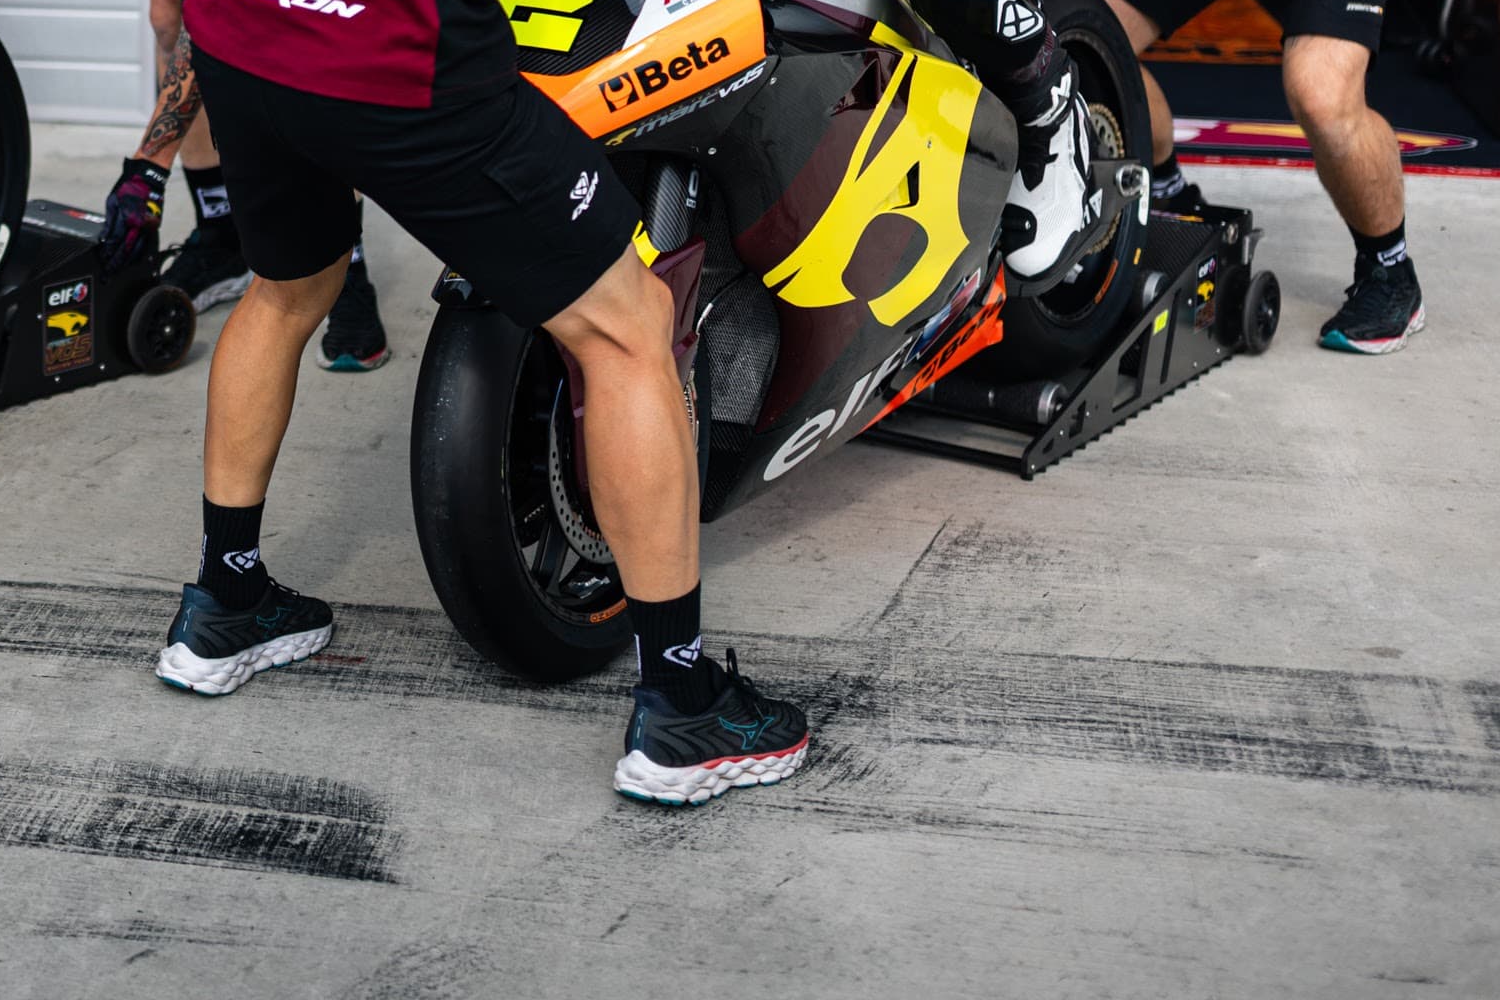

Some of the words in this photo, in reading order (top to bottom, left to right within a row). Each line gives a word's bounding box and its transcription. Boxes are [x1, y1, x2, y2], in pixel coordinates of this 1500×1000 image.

[634, 37, 730, 97] Beta
[49, 287, 74, 306] elf
[763, 336, 914, 481] elf
